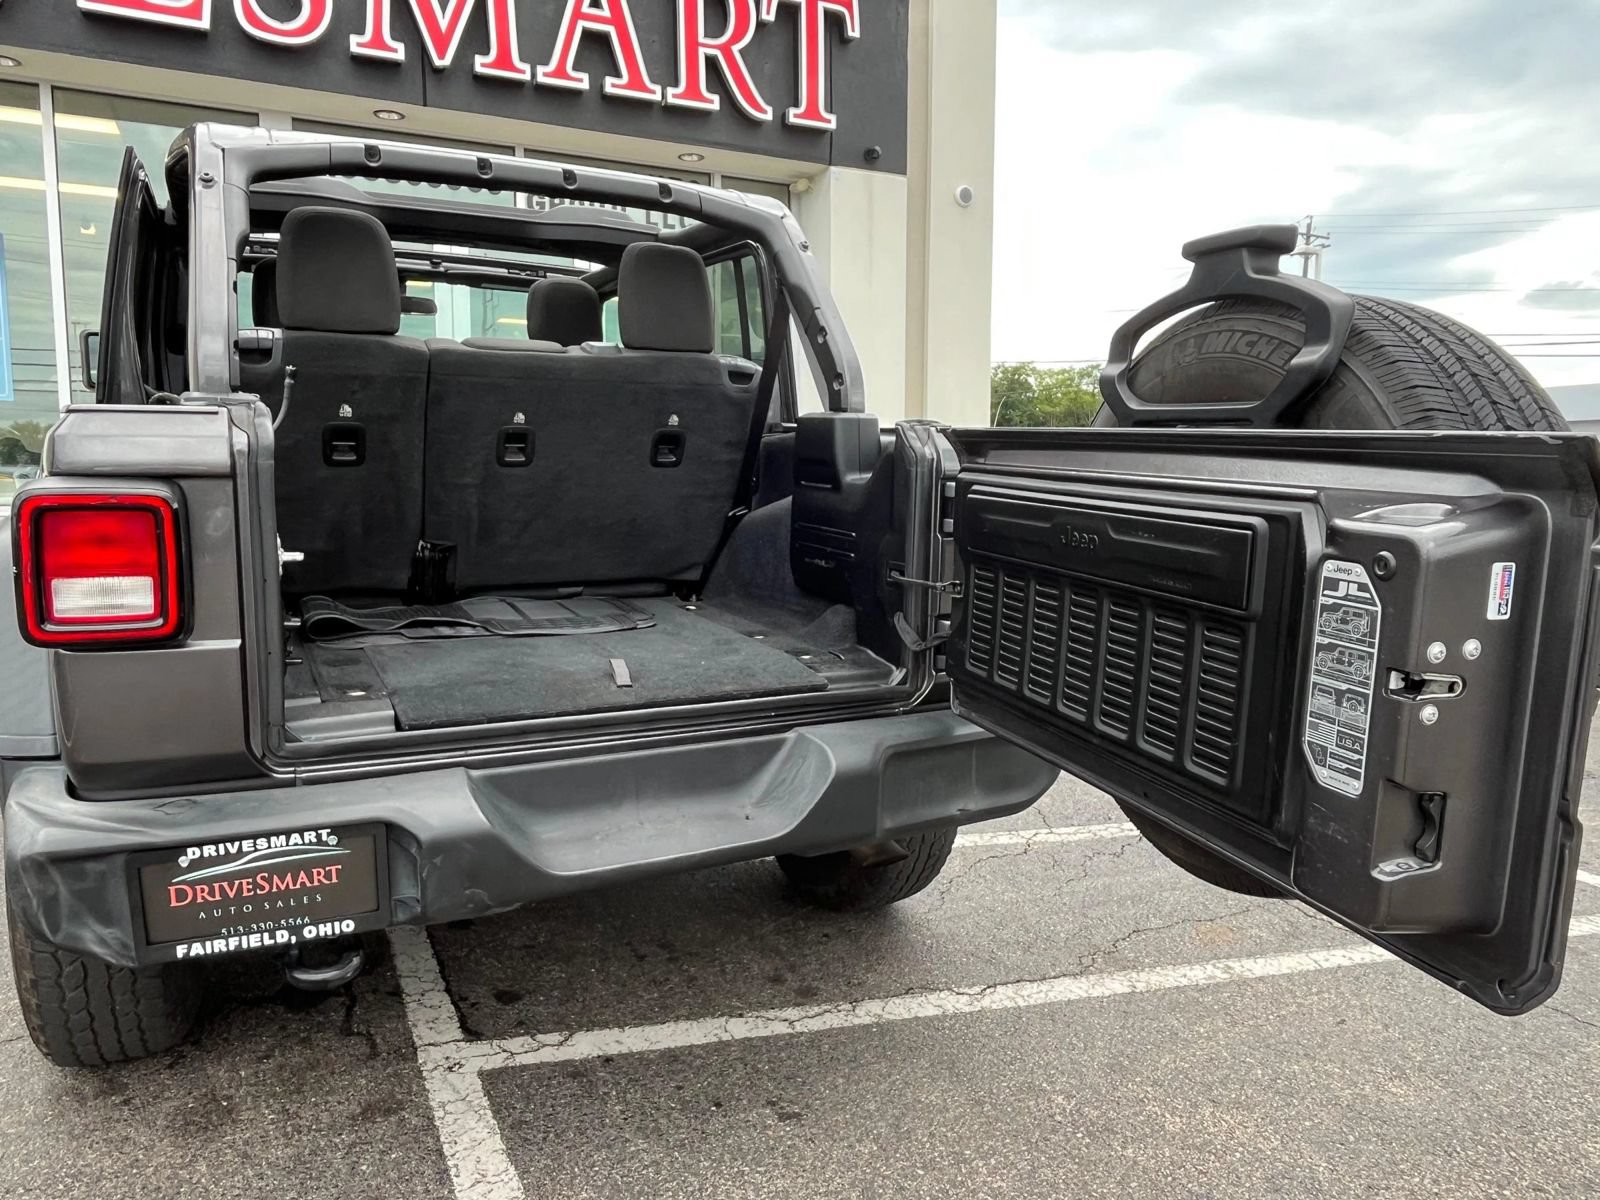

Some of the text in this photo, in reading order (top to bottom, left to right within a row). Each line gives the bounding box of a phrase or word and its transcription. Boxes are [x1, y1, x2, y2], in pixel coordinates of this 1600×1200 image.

[77, 0, 861, 130] MART
[1060, 525, 1098, 549] Jeep
[1333, 564, 1353, 576] Jeep
[186, 829, 332, 860] DRIVESMART
[198, 893, 322, 920] AUTO SALES
[175, 919, 356, 959] FAIRFIELD, OHIO
[220, 916, 311, 936] 513-330-5566
